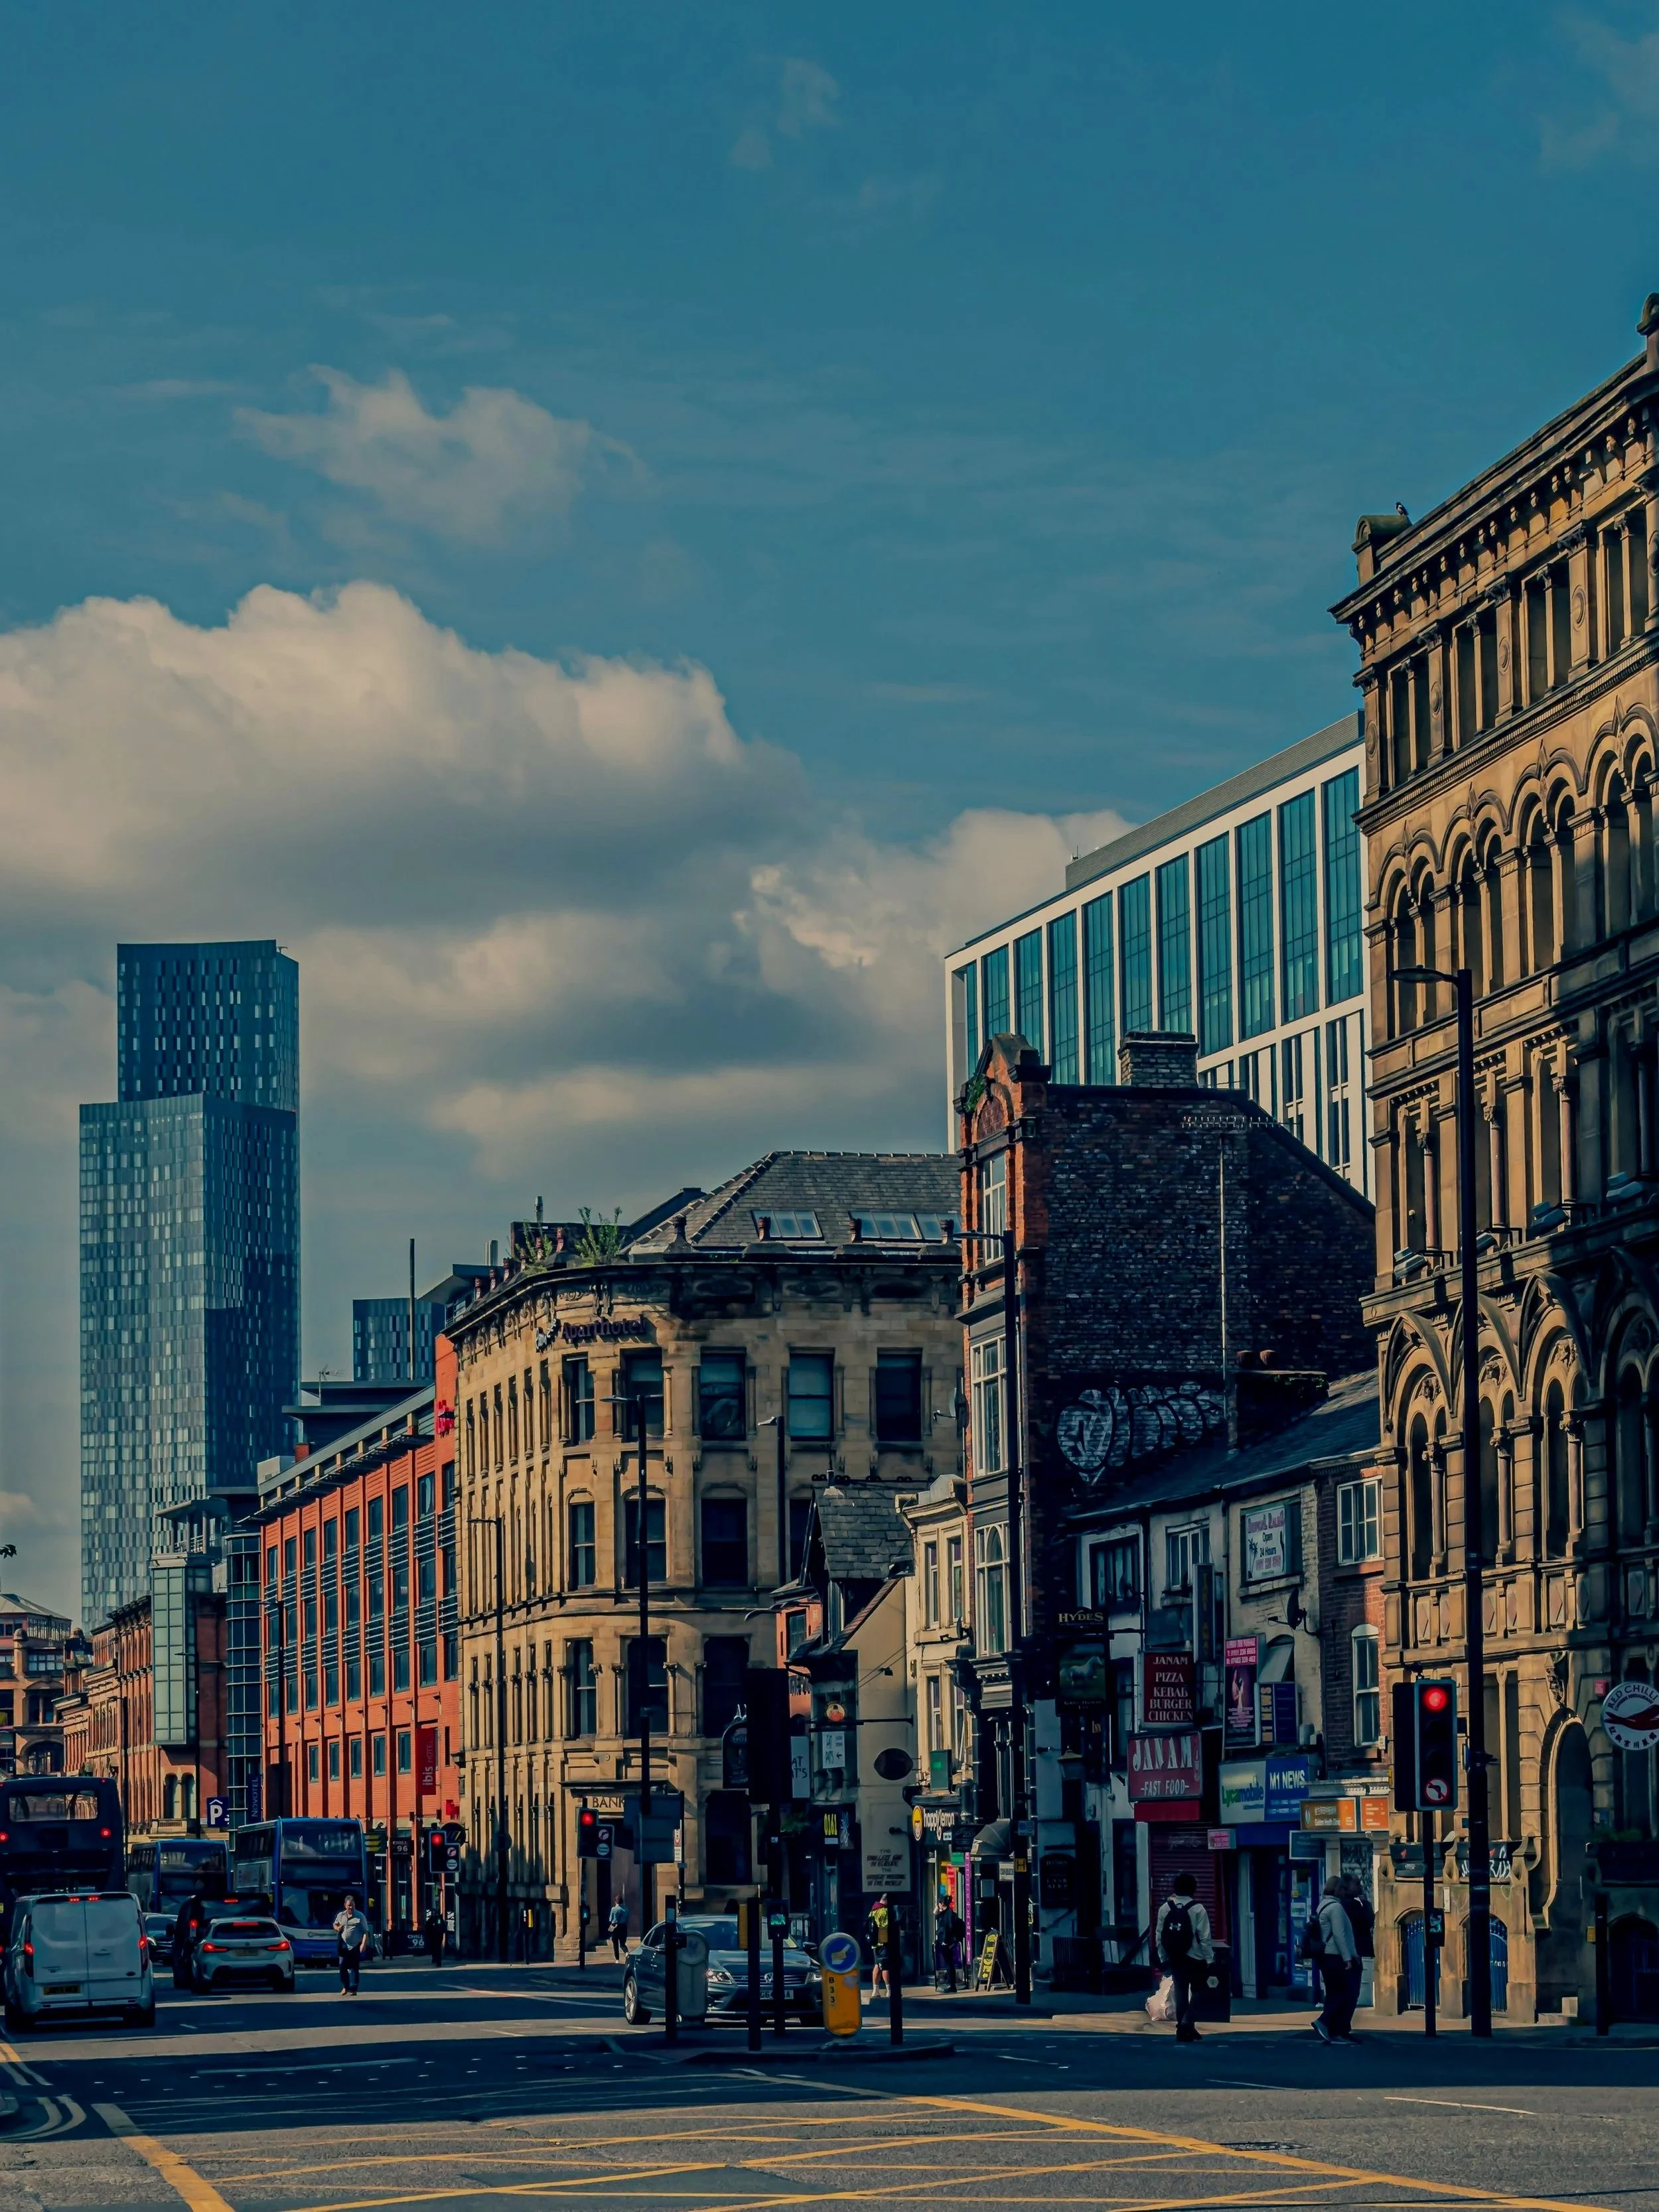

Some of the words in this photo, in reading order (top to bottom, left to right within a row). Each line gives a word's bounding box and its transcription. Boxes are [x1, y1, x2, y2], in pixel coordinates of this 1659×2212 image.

[563, 1319, 646, 1340] Aparthotel
[1058, 1610, 1104, 1623] HYDES
[1153, 1656, 1188, 1665] JANAM
[1155, 1672, 1184, 1683] PIZZA
[1153, 1687, 1188, 1697] KEBAB
[1607, 1691, 1623, 1709] RED
[1624, 1685, 1658, 1700] CHILLI
[1149, 1698, 1192, 1709] BURGER
[1148, 1710, 1193, 1721] CHICKEN
[1133, 1736, 1192, 1771] JANAM
[423, 1766, 433, 1786] ibis
[1269, 1772, 1279, 1789] M1
[1282, 1769, 1305, 1789] NEWS
[210, 1804, 223, 1825] P
